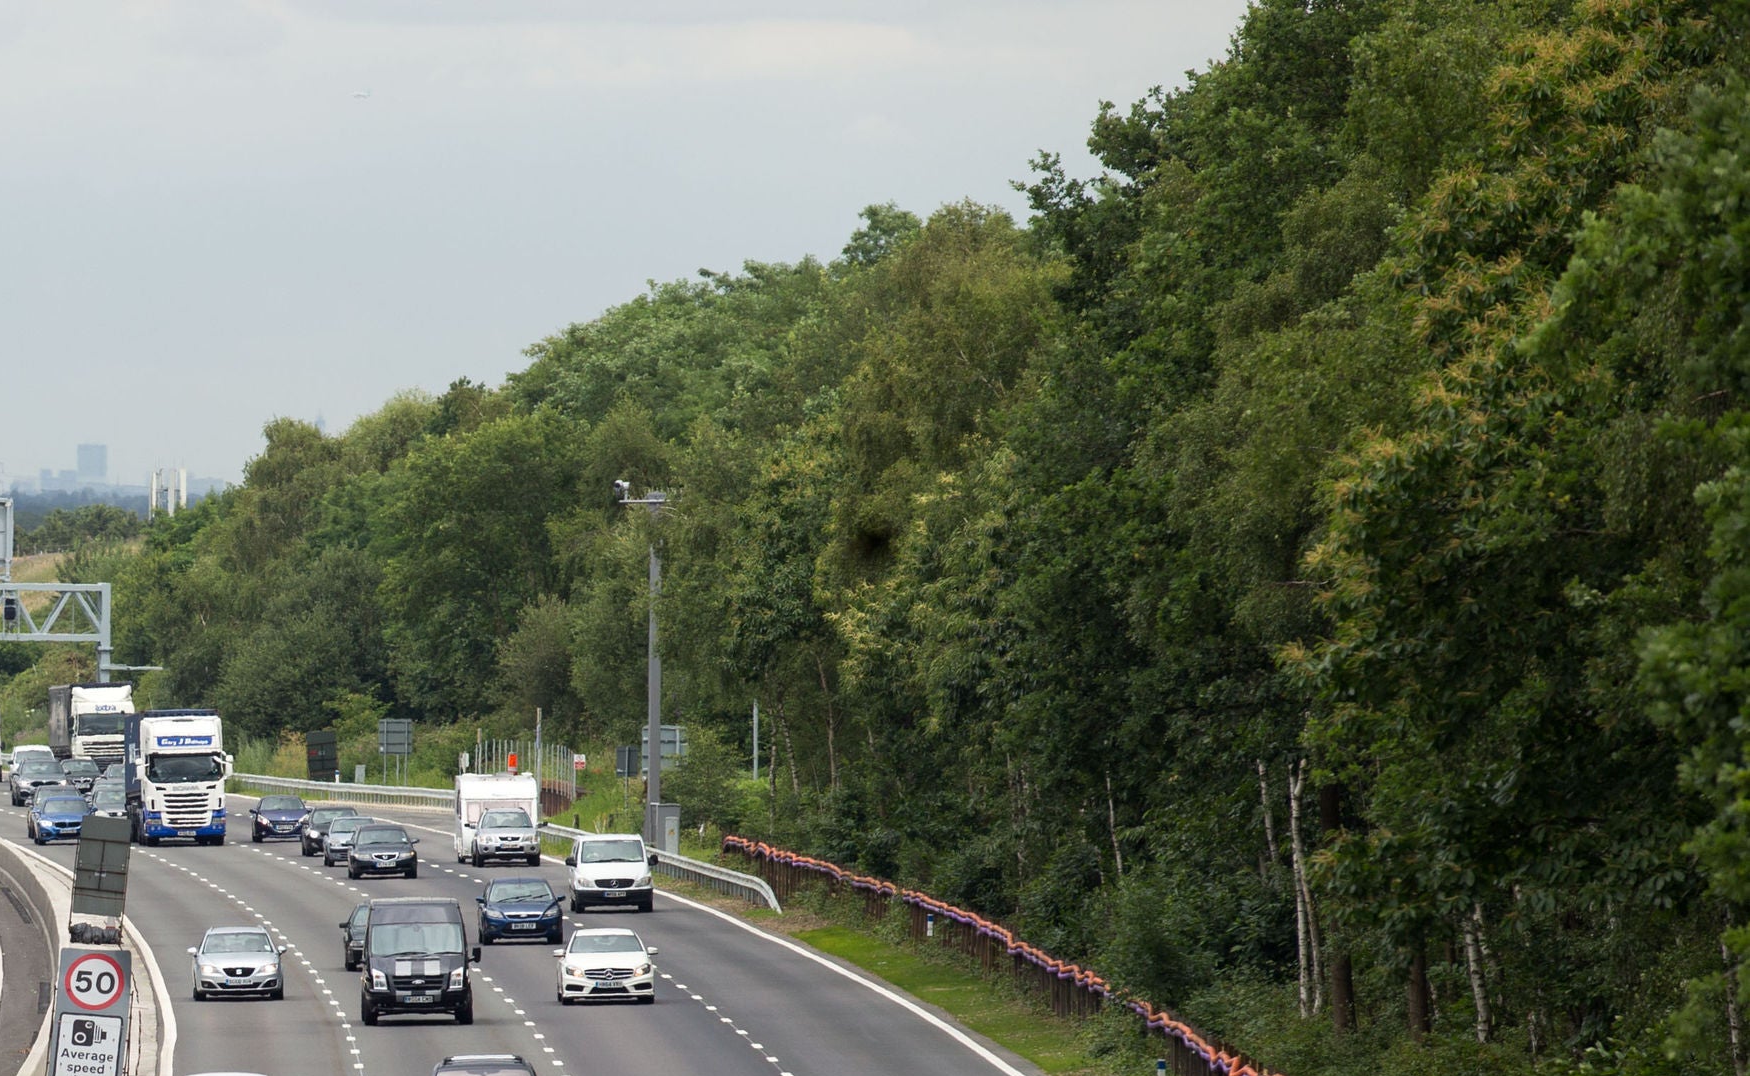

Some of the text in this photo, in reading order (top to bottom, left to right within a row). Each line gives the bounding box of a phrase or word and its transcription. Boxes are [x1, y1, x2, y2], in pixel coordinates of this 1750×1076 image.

[75, 971, 116, 994] 50
[61, 1048, 114, 1063] Average
[66, 1062, 105, 1075] speed
